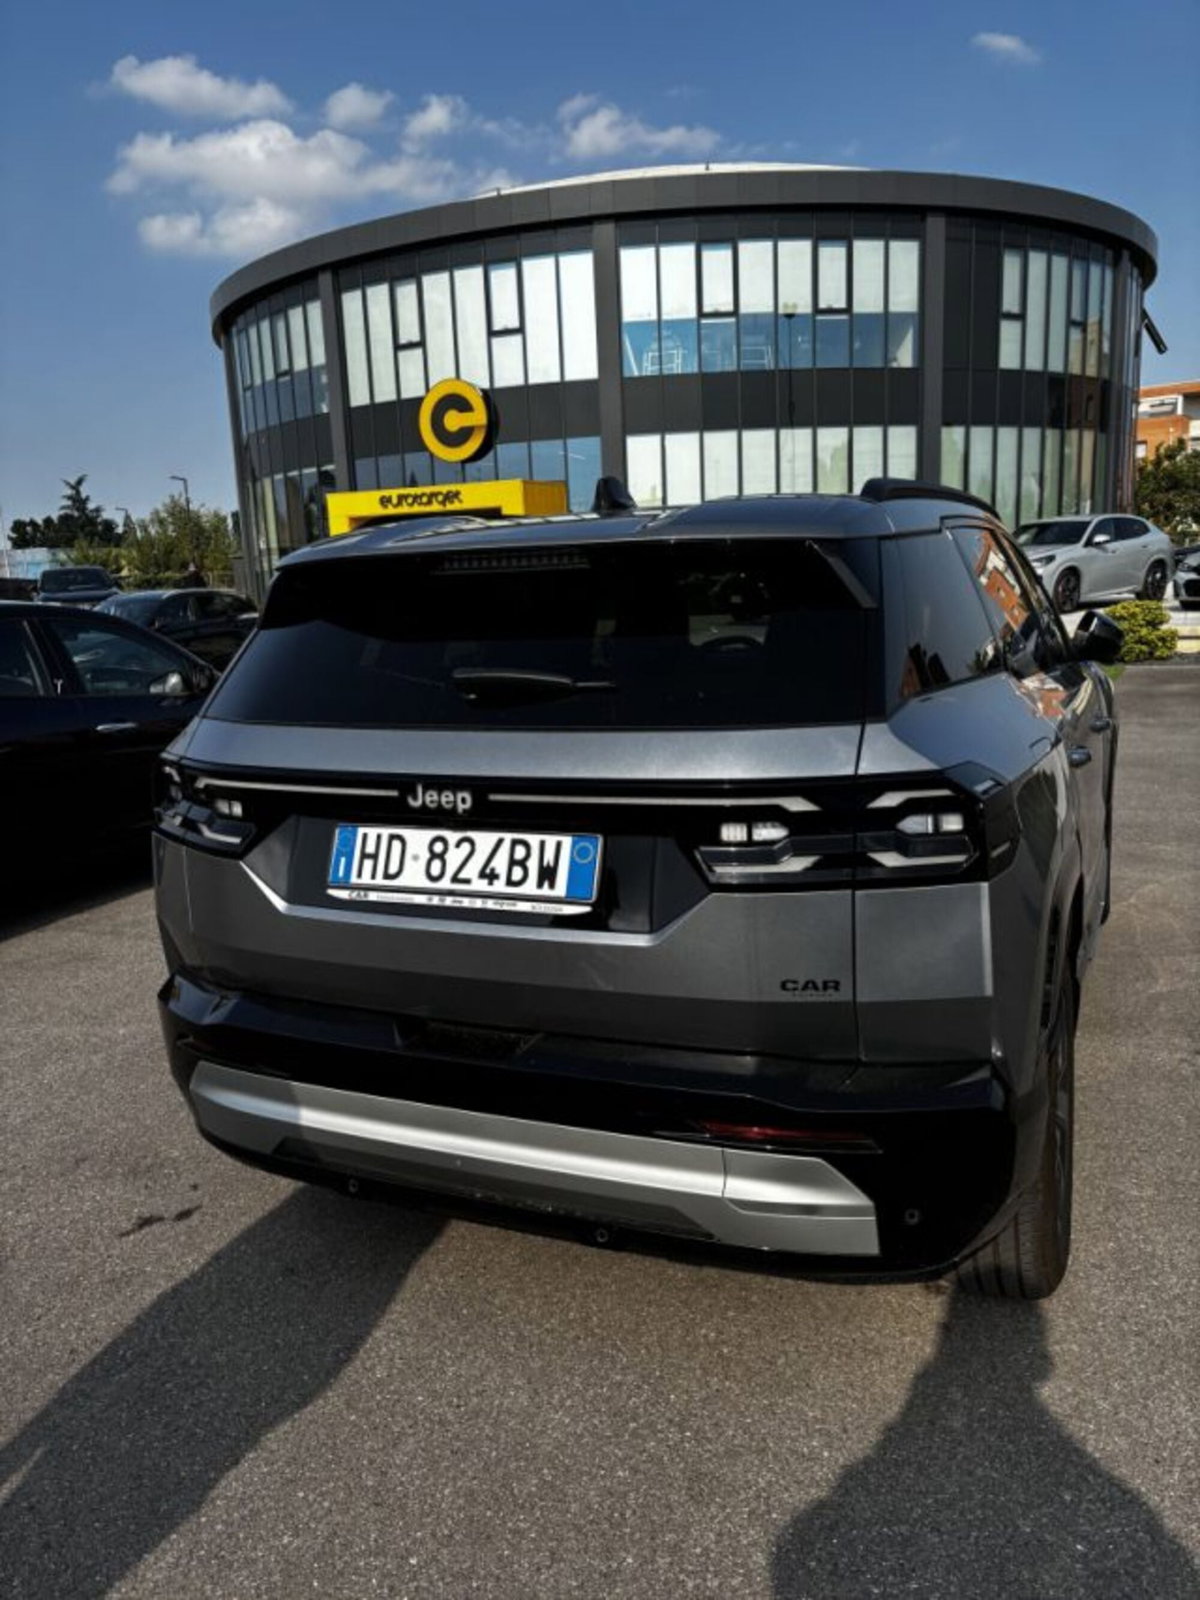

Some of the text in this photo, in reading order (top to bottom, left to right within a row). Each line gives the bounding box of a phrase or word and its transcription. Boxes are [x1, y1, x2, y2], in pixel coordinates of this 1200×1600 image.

[407, 784, 472, 814] Jeep
[356, 832, 563, 890] HD 824BW
[780, 979, 841, 992] CAR
